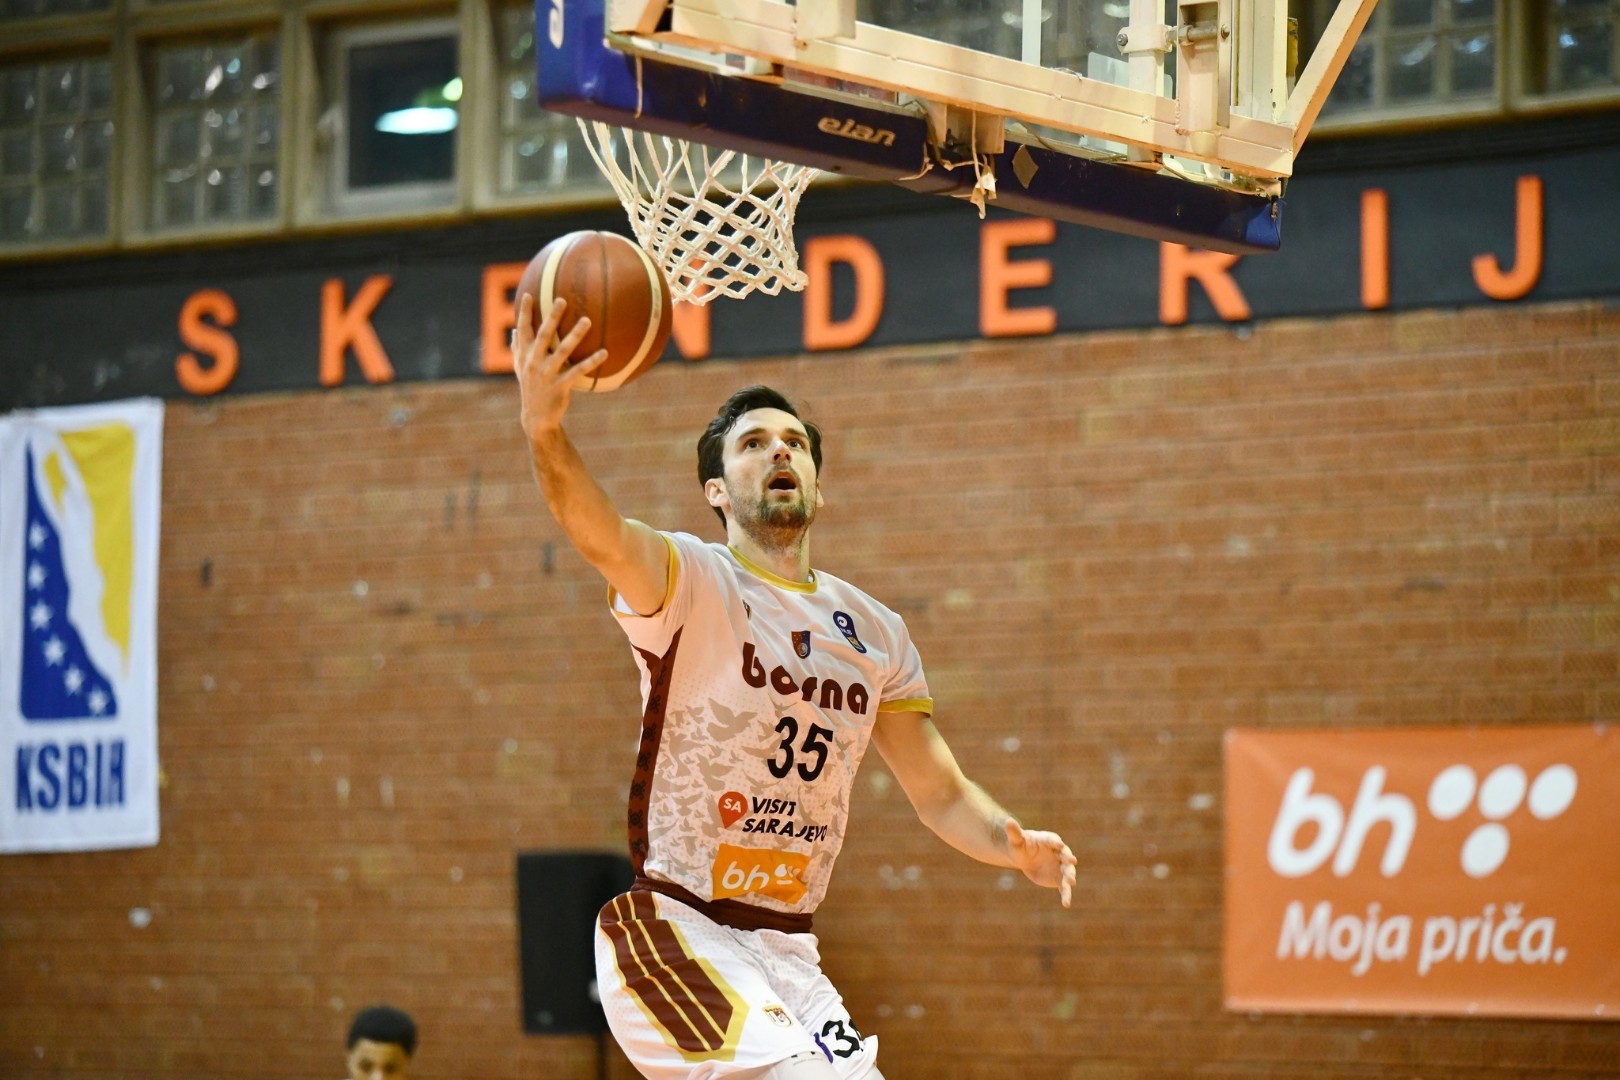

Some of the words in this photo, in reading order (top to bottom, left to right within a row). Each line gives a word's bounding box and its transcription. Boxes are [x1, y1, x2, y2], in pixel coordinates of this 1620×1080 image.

[817, 117, 896, 147] elan
[767, 716, 834, 782] 35
[16, 739, 125, 811] KSBIH
[723, 798, 742, 813] SA
[752, 796, 797, 817] VISIT
[742, 818, 828, 843] SARAJEVO
[1276, 900, 1412, 977] Moja
[1417, 902, 1568, 977] priča.
[821, 1018, 864, 1058] 3
